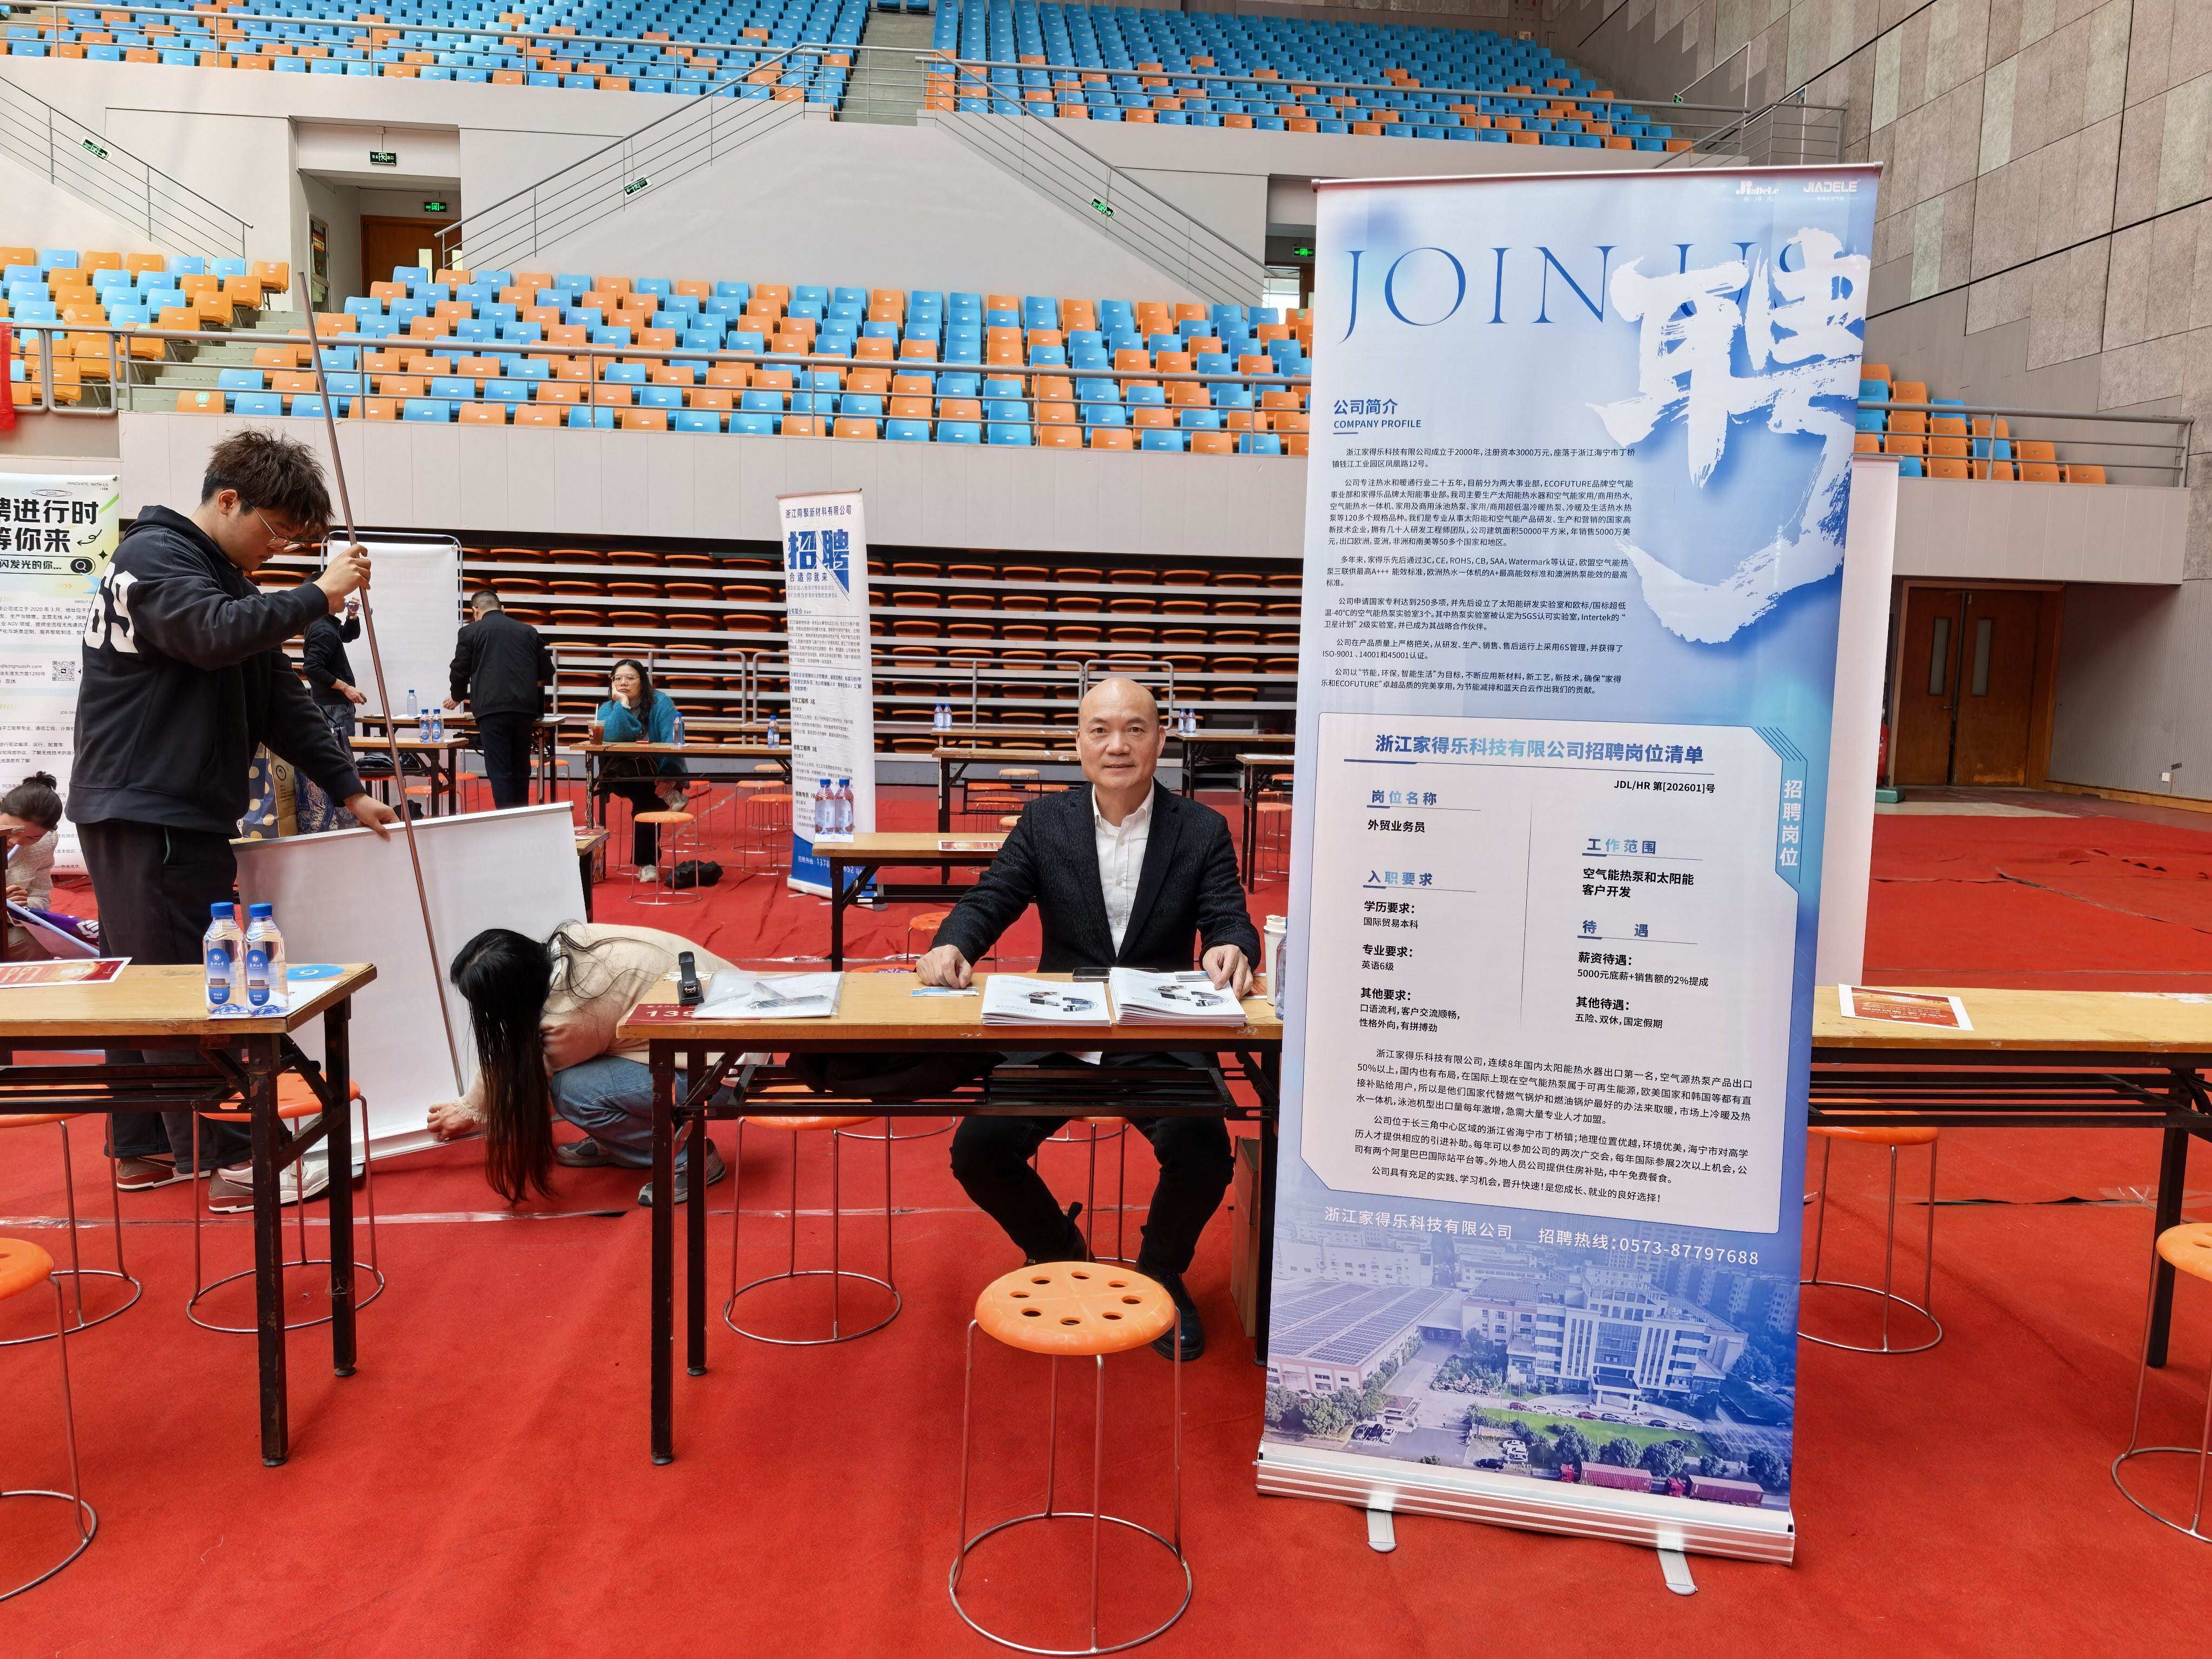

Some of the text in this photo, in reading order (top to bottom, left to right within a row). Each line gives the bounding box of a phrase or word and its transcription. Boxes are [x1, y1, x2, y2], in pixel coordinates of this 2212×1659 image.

[1803, 181, 1858, 193] JIADELE
[1338, 245, 1618, 345] JOIN
[1334, 399, 1398, 416] 公司简介
[1334, 419, 1421, 429] COMPANY PROFILE
[1332, 460, 1429, 469] 镇钱江工业园区凤凰路12号。
[786, 504, 852, 518] 浙江同聚新材料有限公司
[788, 529, 849, 570] 招聘
[790, 571, 828, 582] 合适你就来
[1326, 579, 1344, 587] 标准。
[1375, 734, 1704, 765] 浙江家得乐科技有限公司招聘岗位清单
[1614, 781, 1651, 792] JDL/HR
[1372, 790, 1437, 806] 岗位名称
[1367, 819, 1426, 834] 外贸业务员
[1779, 779, 1802, 868] 招聘岗位
[1587, 838, 1656, 855] 工作范围
[1367, 870, 1433, 887] 入职要求
[1583, 868, 1694, 886] 空气能热泵和太阳能
[1582, 883, 1631, 899] 客户开发
[1364, 900, 1416, 915] 学历要求：
[1363, 916, 1419, 930] 国际贸易本科
[1362, 943, 1413, 959] 专业要求：
[1361, 960, 1394, 973] 英语6级
[1579, 952, 1632, 967] 薪资待遇：
[1577, 968, 1709, 988] 5000元底薪+销售额的2%提成
[1360, 987, 1411, 1002] 其他要求：
[1576, 996, 1630, 1012] 其他待遇：
[1359, 1017, 1438, 1034] 性格外向，有拼搏劲
[1575, 1013, 1663, 1030] 五险、双休，国定假期
[1325, 1207, 1513, 1240] 浙江家得乐科技有限公司
